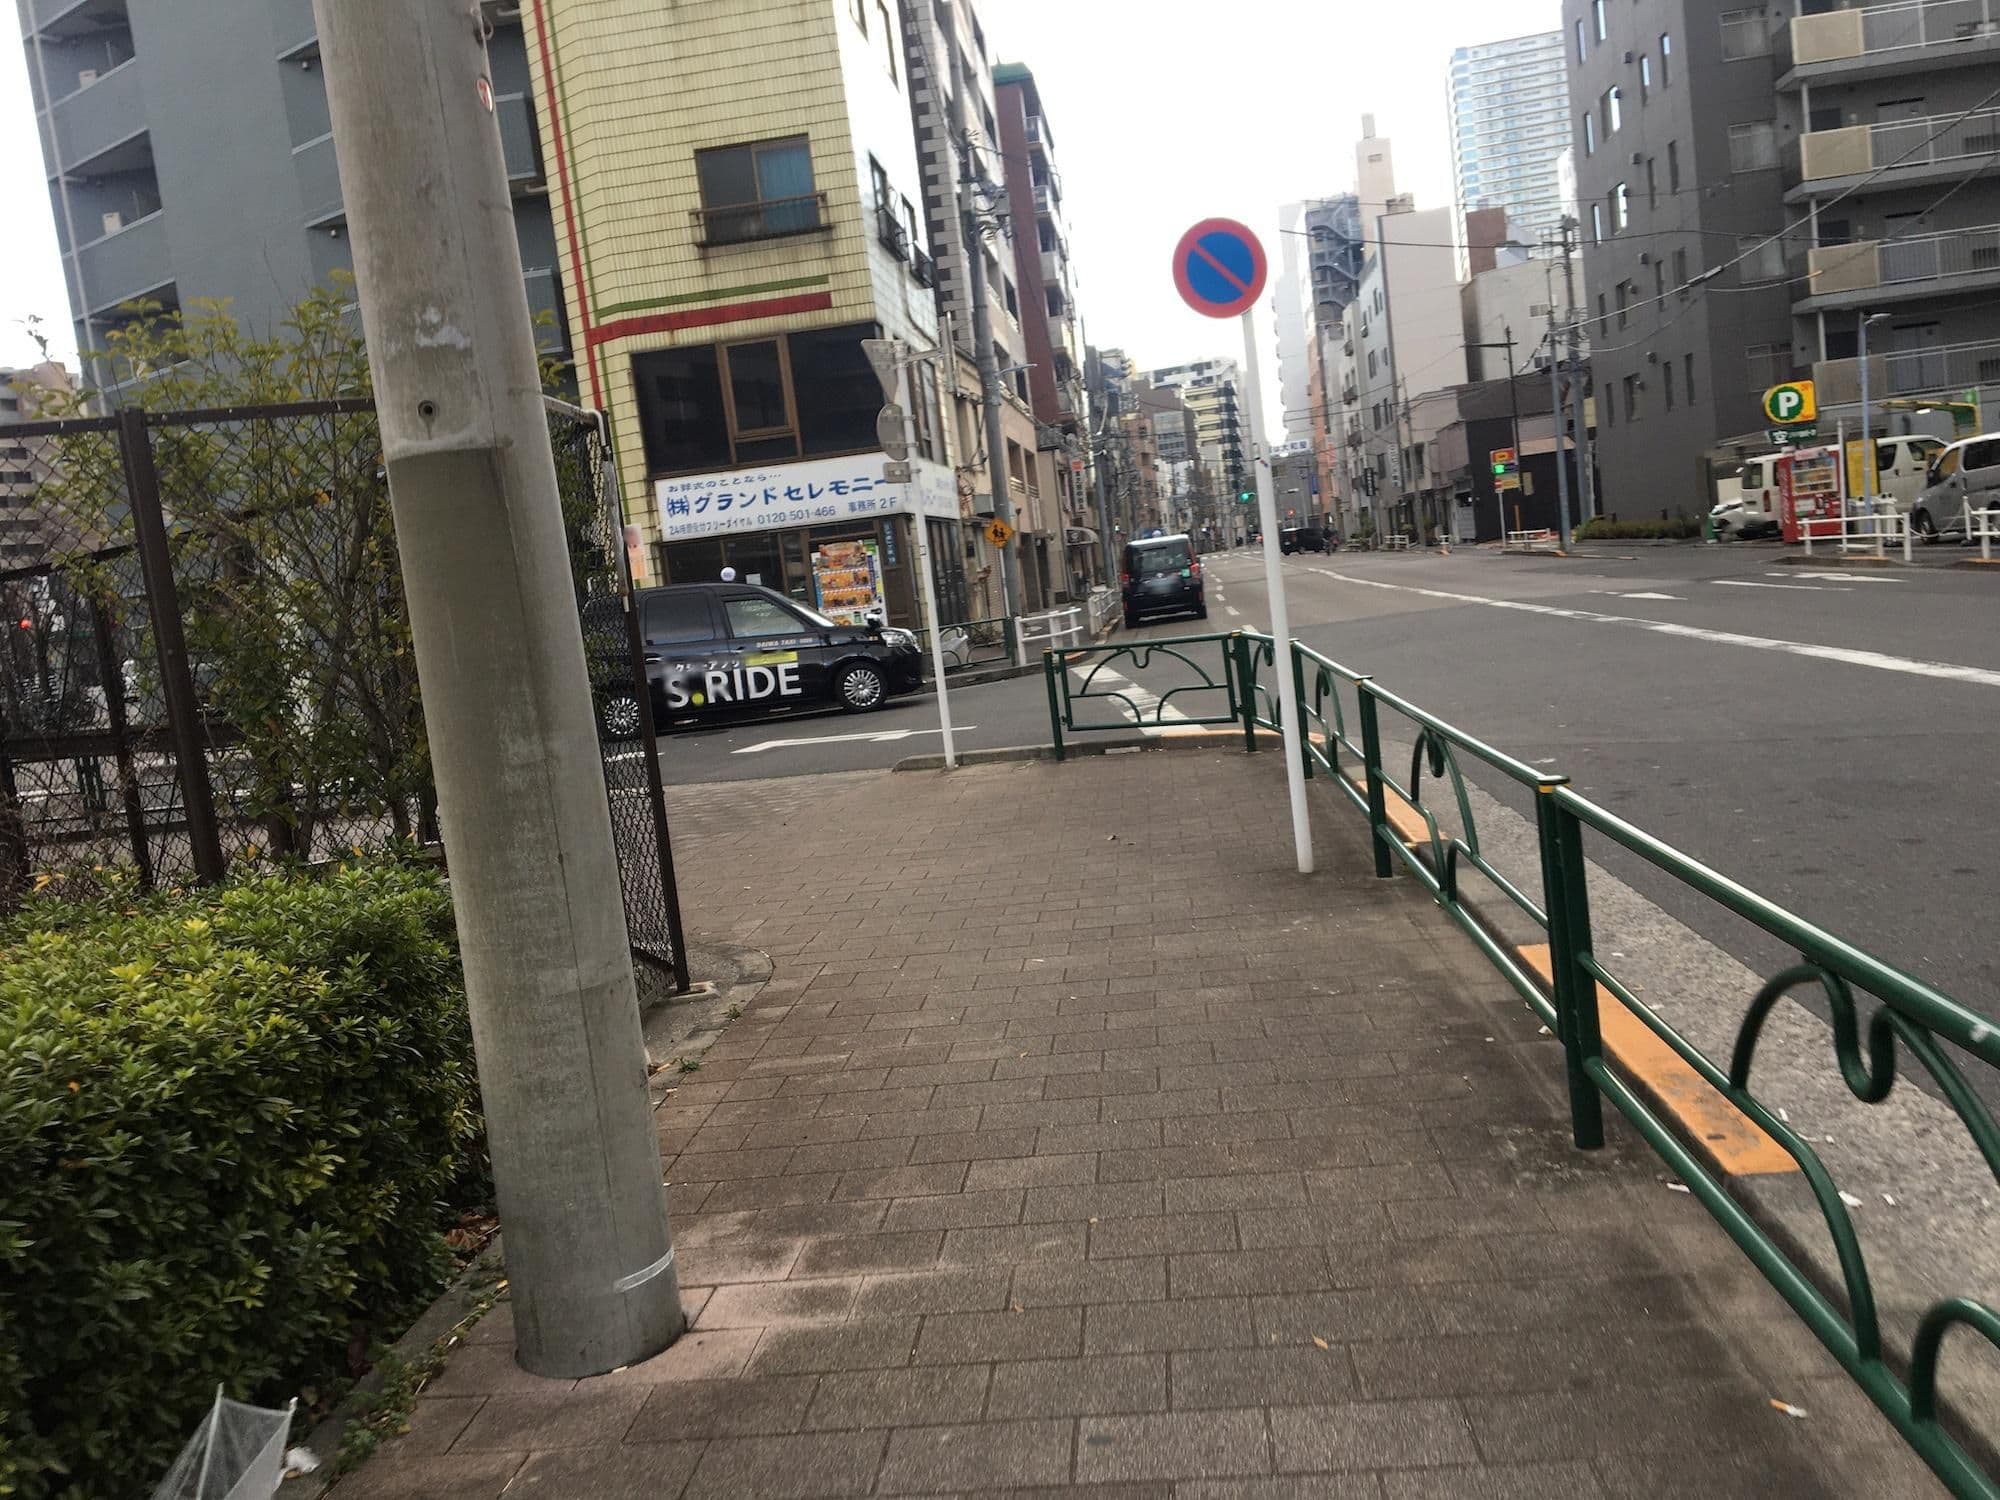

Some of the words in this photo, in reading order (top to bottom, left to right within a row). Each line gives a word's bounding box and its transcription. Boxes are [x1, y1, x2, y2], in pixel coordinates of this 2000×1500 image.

[1777, 391, 1800, 418] P
[847, 498, 877, 513] 事務所
[879, 496, 898, 510] 2F
